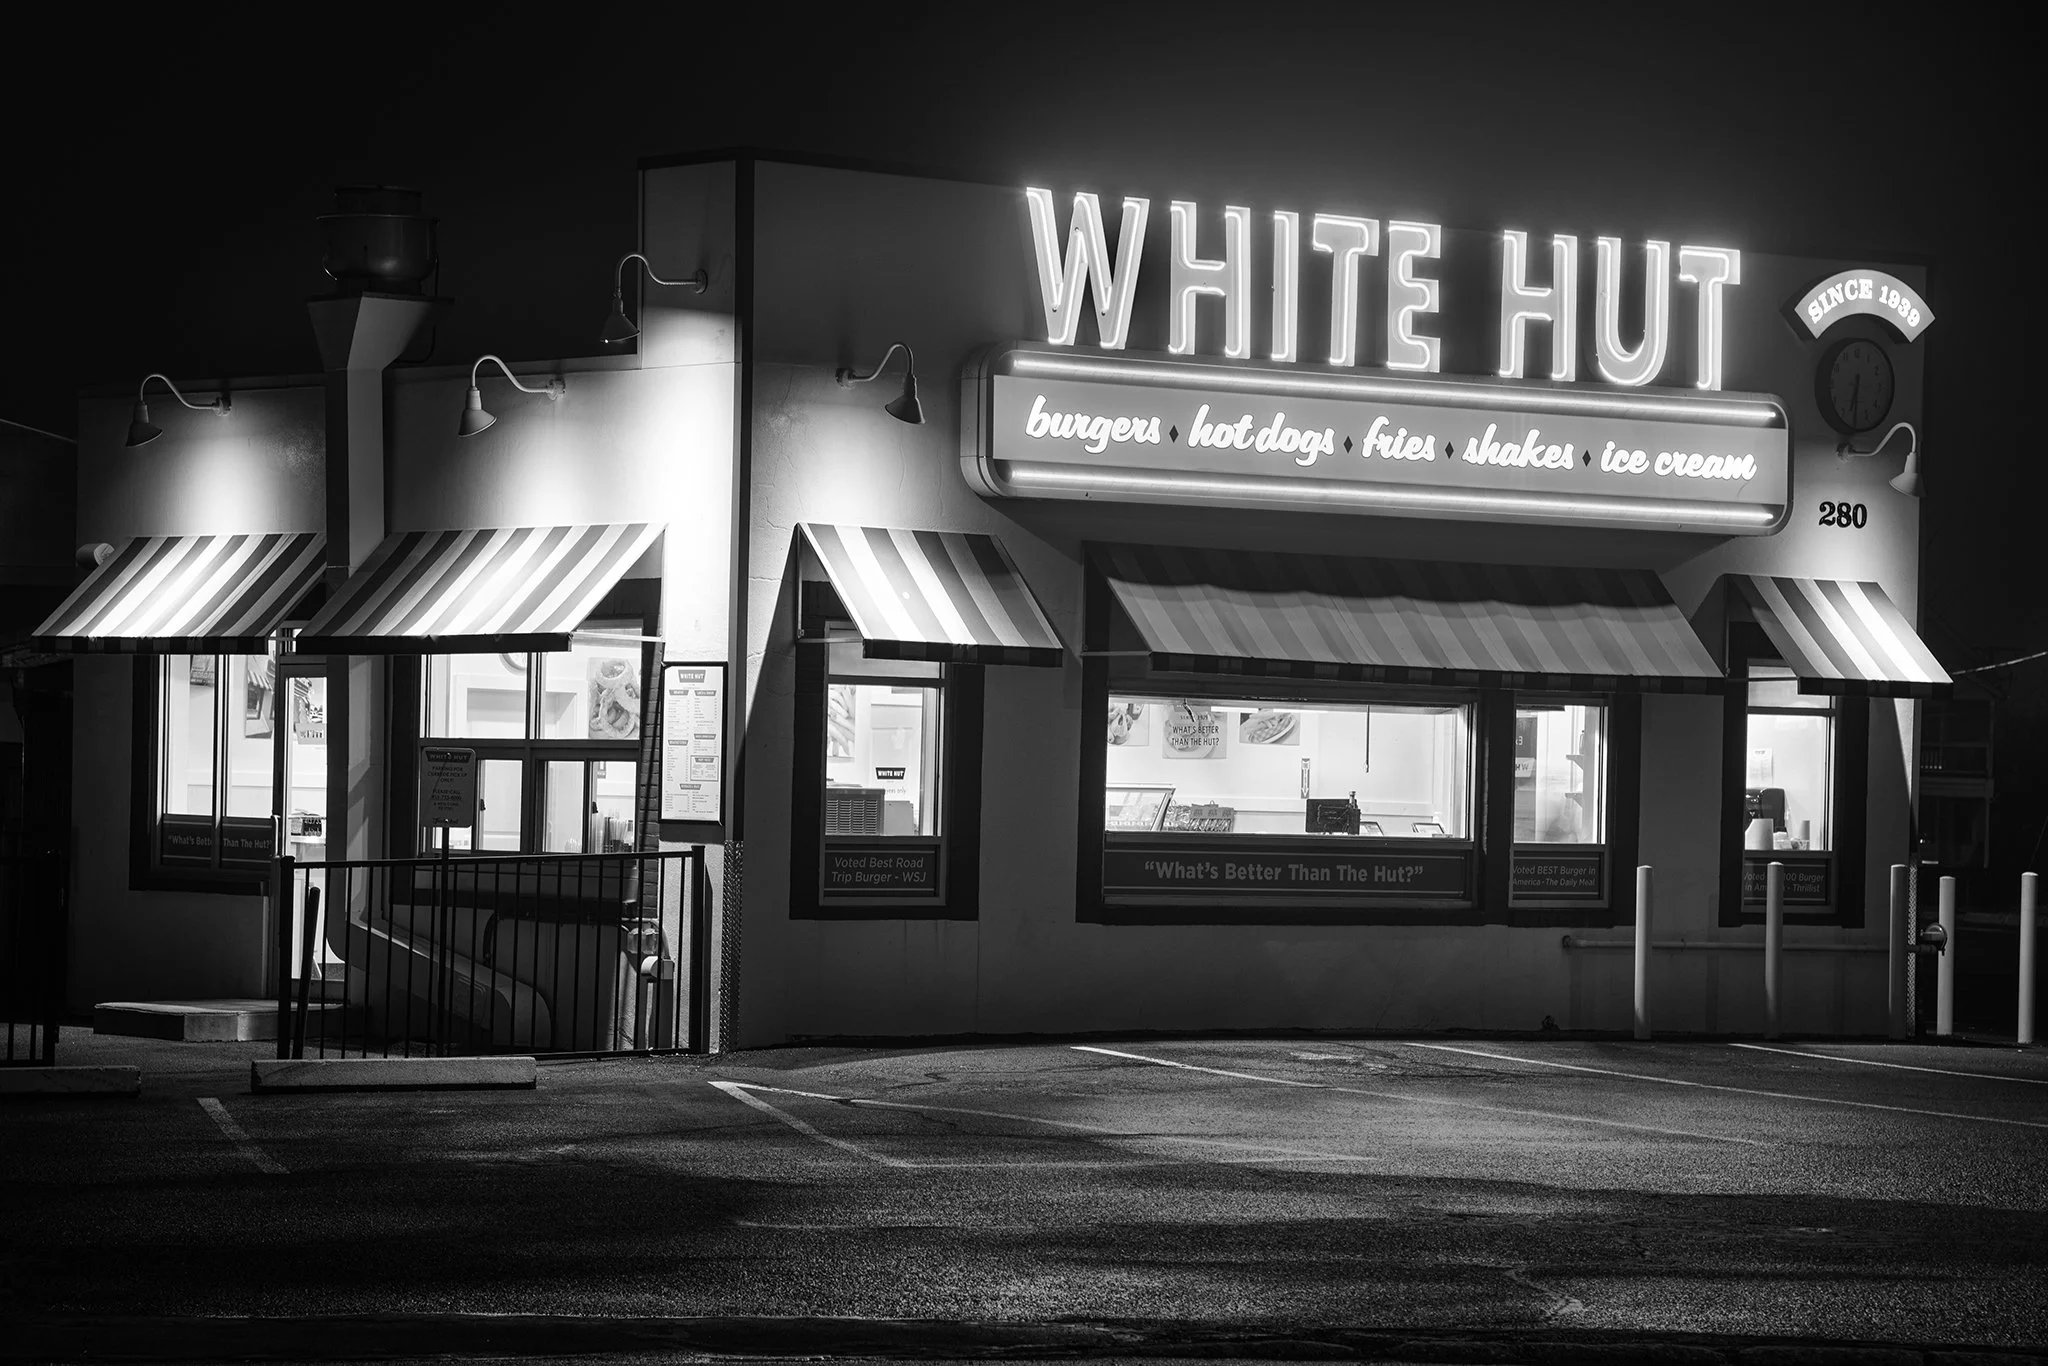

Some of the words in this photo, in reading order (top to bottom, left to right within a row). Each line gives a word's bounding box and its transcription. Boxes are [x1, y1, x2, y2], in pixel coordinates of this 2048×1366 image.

[1026, 186, 1441, 373] WHITE
[1499, 229, 1741, 391] HUT
[1807, 278, 1873, 324] SINCE
[1878, 285, 1921, 328] 1939
[1024, 394, 1162, 454] burgers
[1361, 415, 1437, 462] fries
[1461, 422, 1575, 471] shakes
[1600, 440, 1650, 475] ice
[1653, 449, 1758, 481] cream
[1818, 501, 1868, 529] 280
[1172, 725, 1197, 734] WHAT'S
[1198, 725, 1220, 734] BETTER
[1171, 737, 1189, 746] THAN
[1190, 737, 1202, 746] THE
[1203, 737, 1220, 746] HUT?
[196, 836, 212, 847] Bett
[223, 837, 239, 848] Than
[241, 838, 253, 849] The
[834, 857, 866, 869] Voted
[869, 857, 893, 869] Best
[896, 857, 924, 869] Road
[1224, 863, 1282, 881] Better
[1288, 863, 1331, 882] Than
[1336, 864, 1368, 882] The
[1513, 865, 1536, 875] Voted
[1537, 865, 1559, 875] BEST
[1560, 865, 1587, 876] Burger
[1588, 866, 1596, 875] in
[832, 871, 852, 884] Trip
[855, 871, 892, 884] Burger
[902, 871, 927, 883] WSJ
[1513, 878, 1541, 886] America
[1546, 878, 1558, 886] The
[1560, 878, 1578, 888] Daily
[1579, 878, 1595, 886] Meal
[1799, 872, 1824, 883] Burger
[1793, 883, 1820, 893] Thrillist
